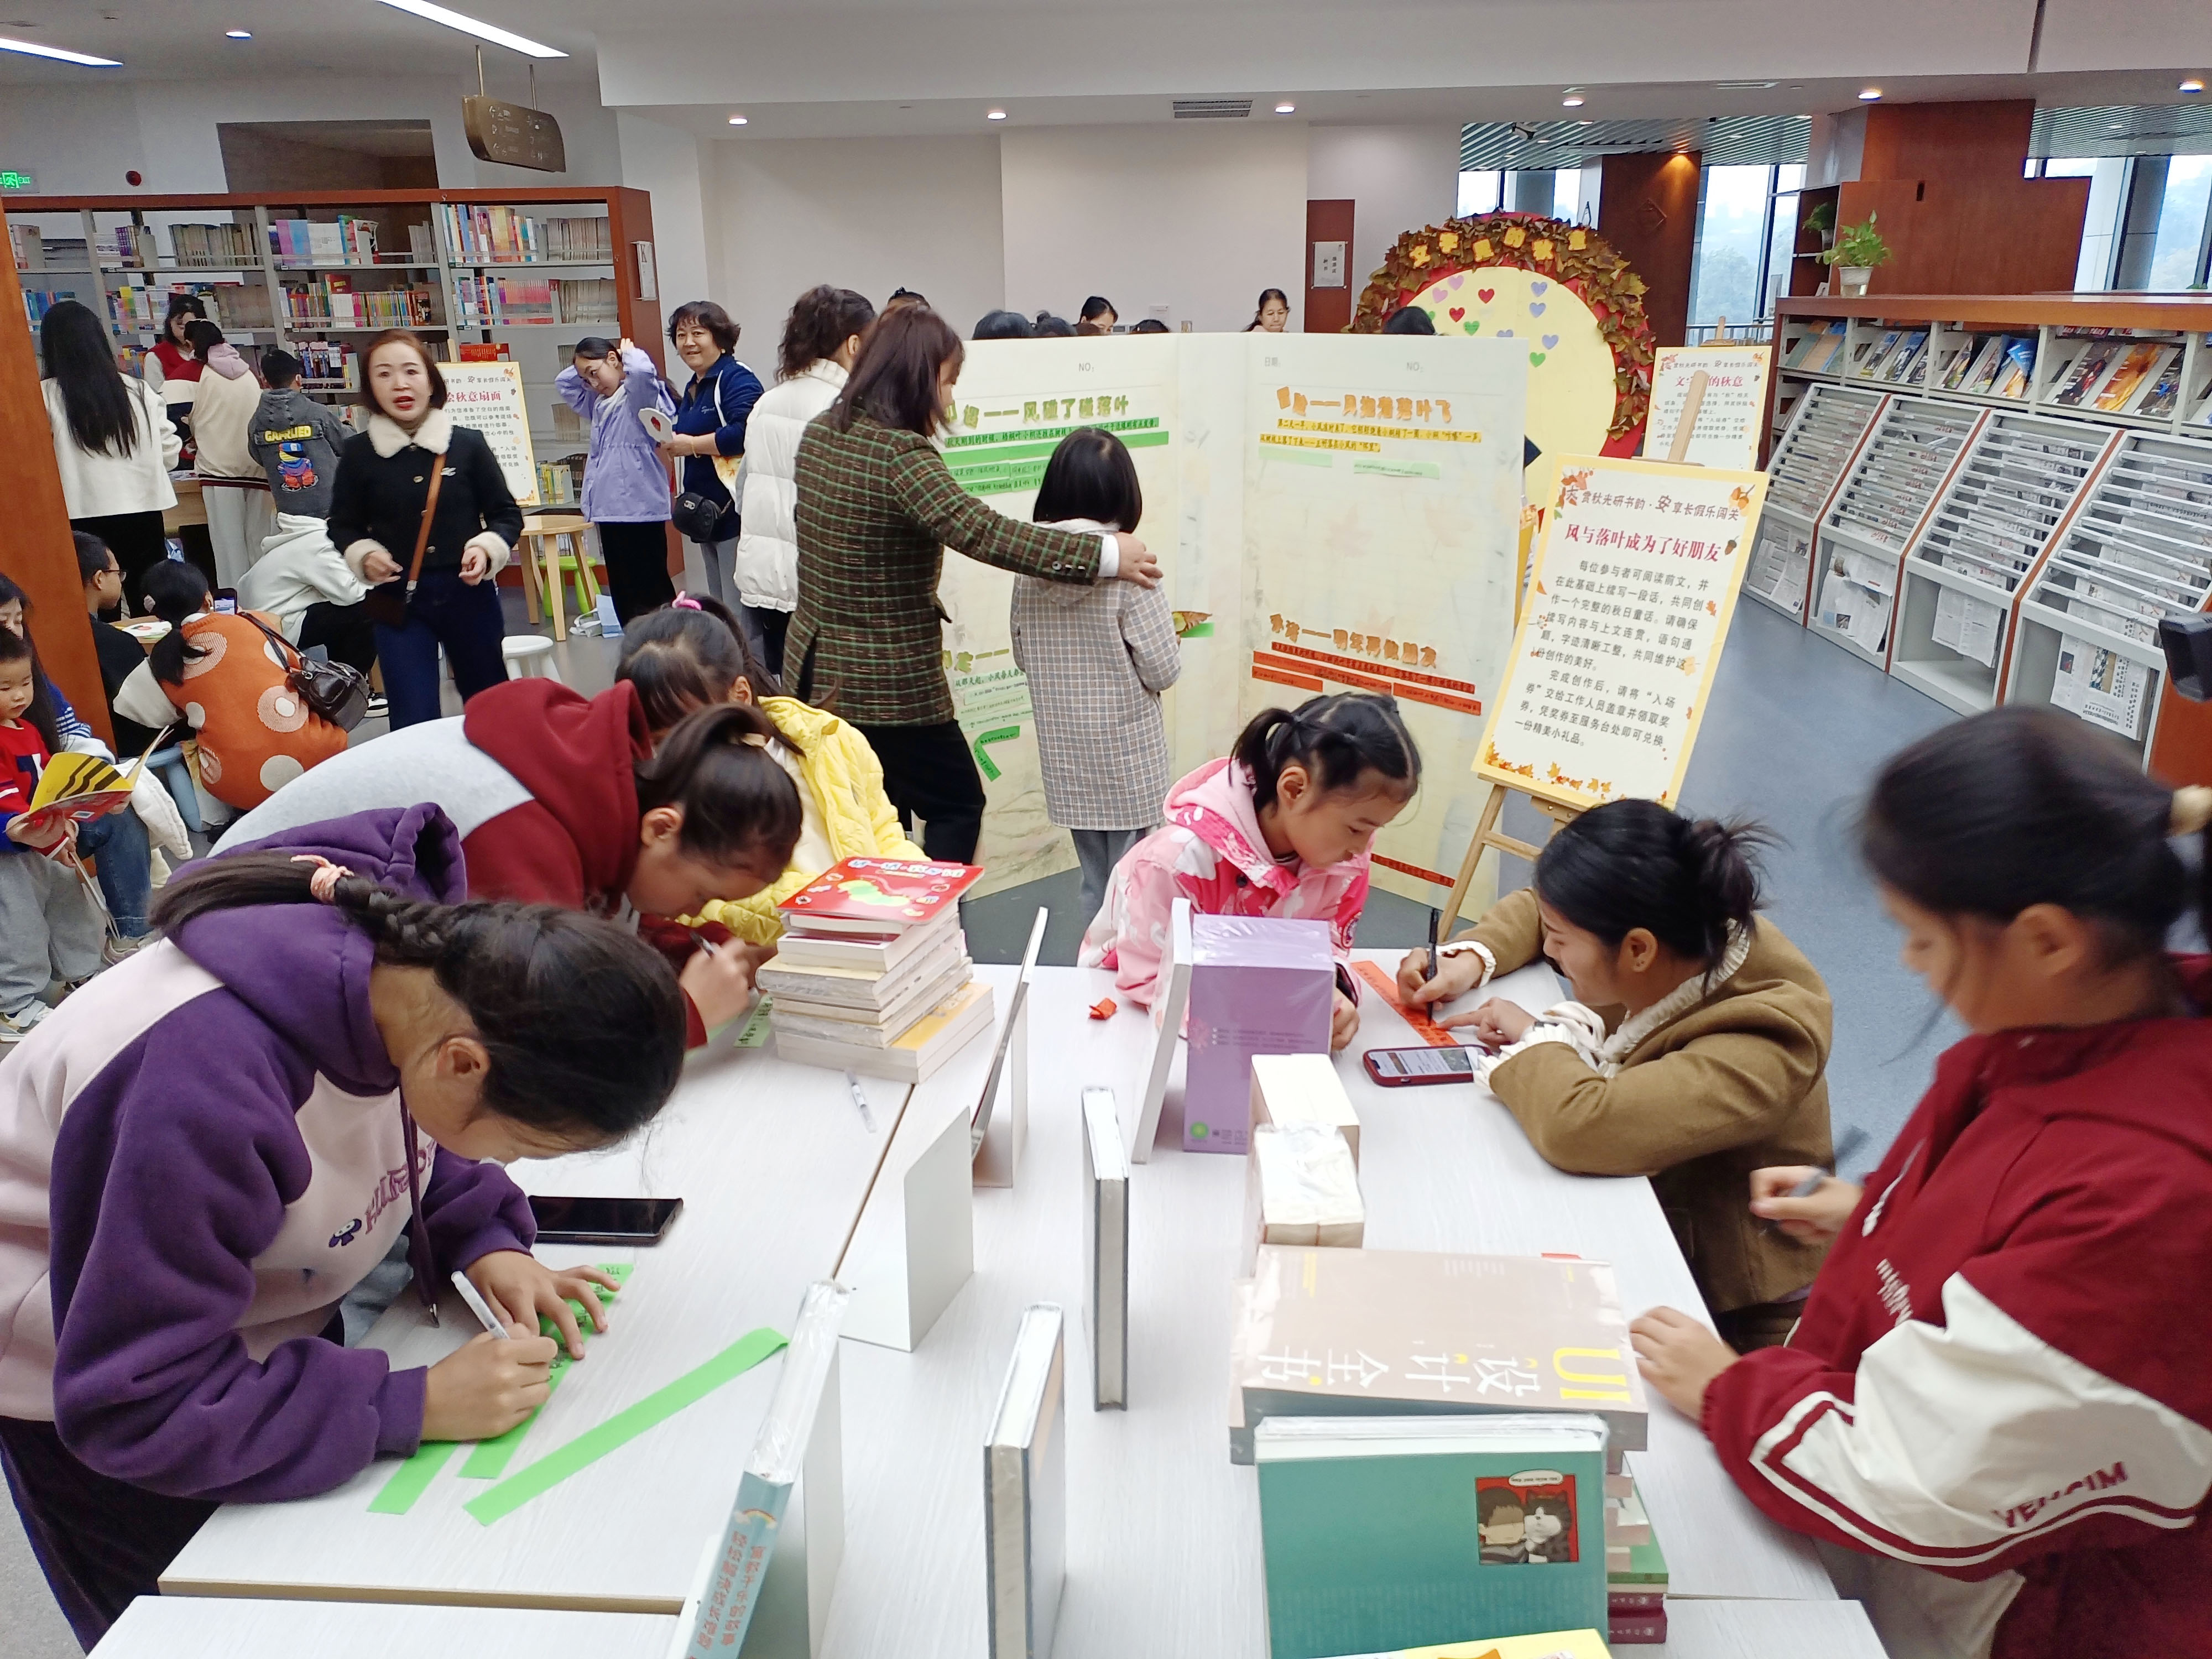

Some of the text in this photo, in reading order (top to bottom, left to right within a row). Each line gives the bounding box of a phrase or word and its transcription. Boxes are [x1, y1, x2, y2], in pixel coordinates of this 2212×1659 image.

[640, 244, 647, 263] K
[1564, 524, 1721, 562] 风与落叶成为了好朋友
[1555, 575, 1704, 612] 在此基础上续写一段话，共同创
[1579, 560, 1709, 591] 每位参与者可阅读前文，并
[1551, 593, 1698, 630] 作一个完整的秋日童话。请确保
[1520, 700, 1663, 747] 券，凭奖券至服务台处即可兑换
[1526, 682, 1670, 728] 券”交给工作人员盖章并领取奖
[1515, 719, 1584, 747] 一份精美小礼品。
[1258, 1344, 1541, 1398] 设计全书
[1552, 1346, 1631, 1404] UI
